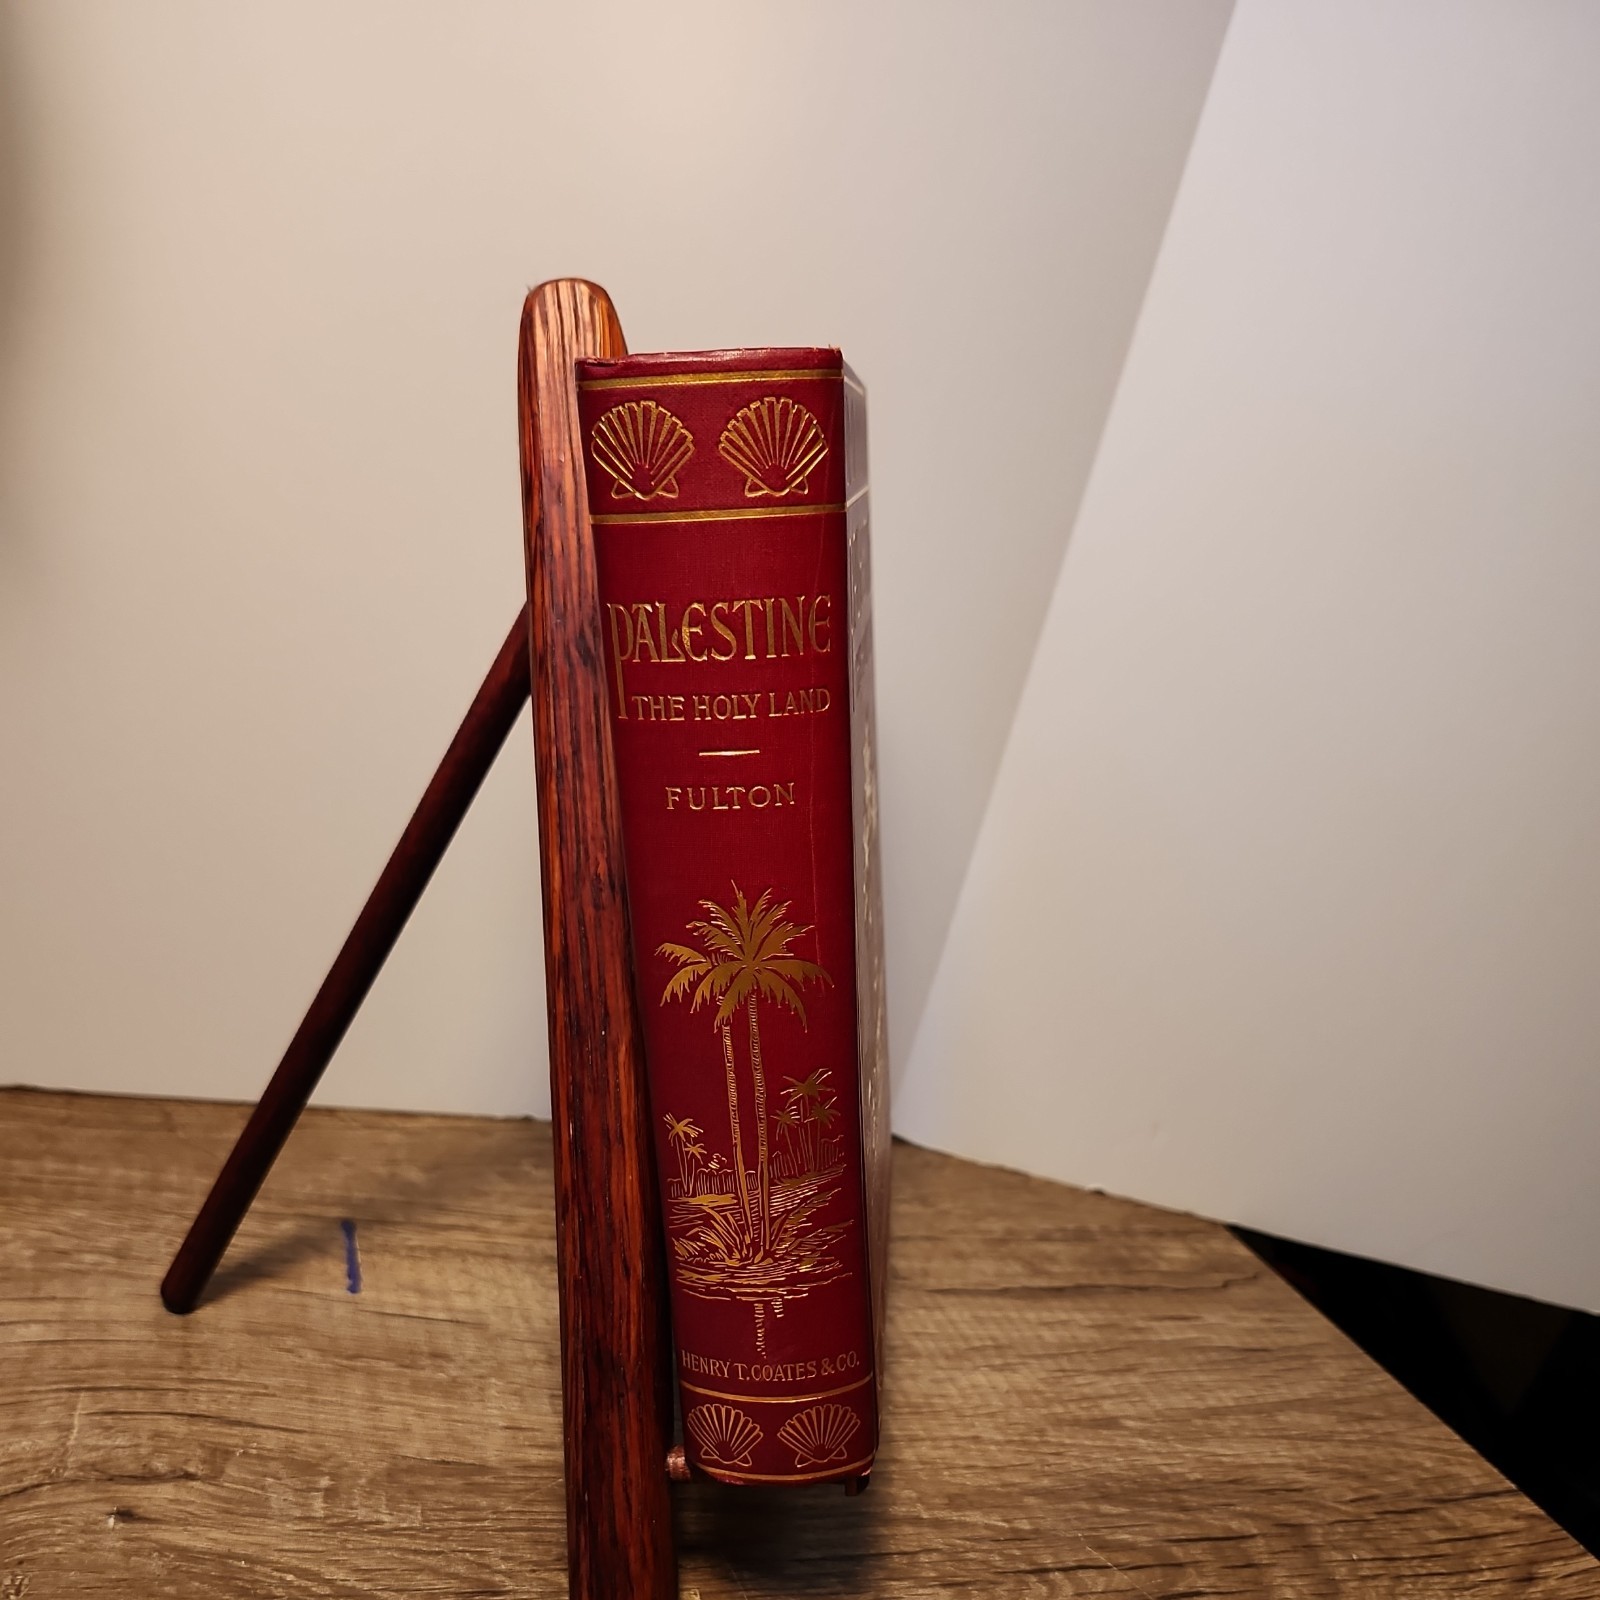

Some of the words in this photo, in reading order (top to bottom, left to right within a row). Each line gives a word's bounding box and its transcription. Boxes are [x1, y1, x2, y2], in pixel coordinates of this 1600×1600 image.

[607, 595, 831, 719] PALESTINE
[631, 696, 685, 721] THE
[694, 693, 761, 720] HOLY
[769, 688, 831, 718] LAND
[665, 782, 795, 810] FULTON
[681, 1350, 730, 1379] HENRY
[751, 1360, 817, 1382] COATES
[821, 1357, 835, 1376] &
[836, 1351, 860, 1372] CO.
